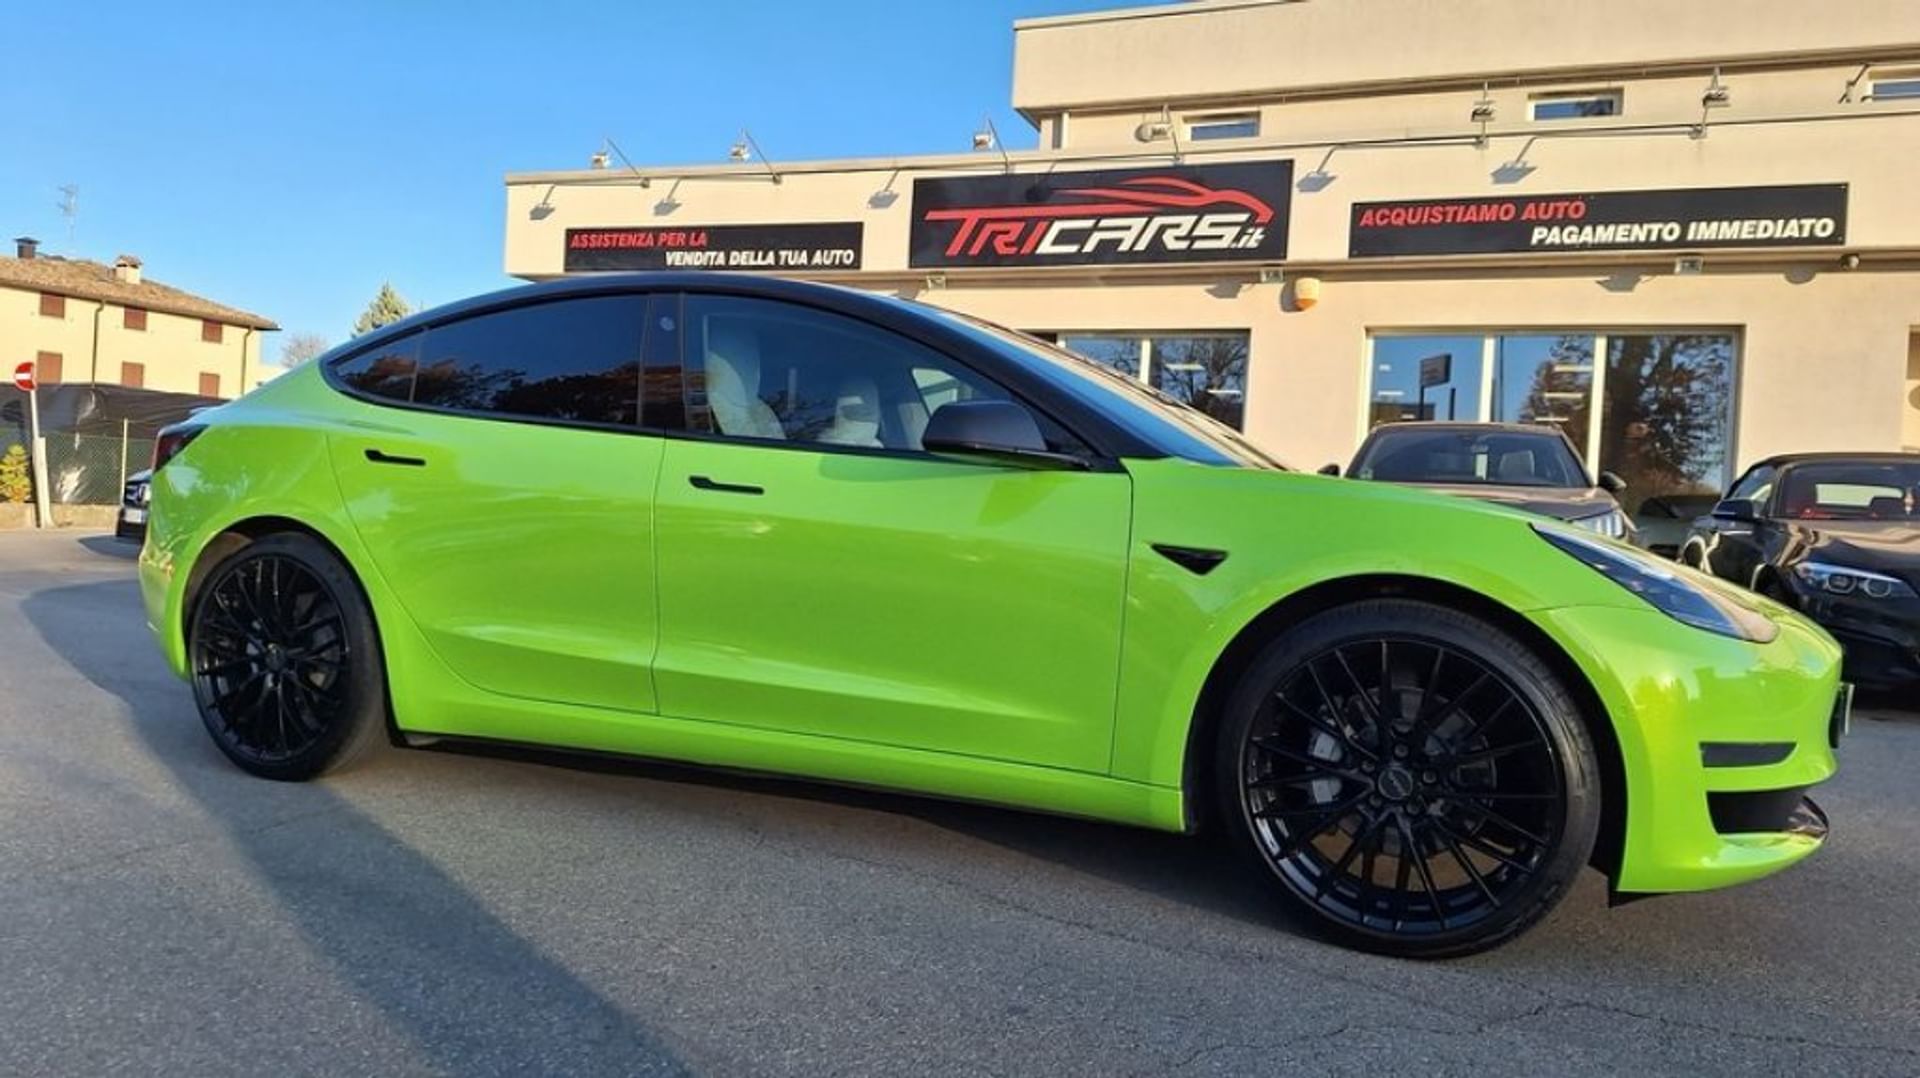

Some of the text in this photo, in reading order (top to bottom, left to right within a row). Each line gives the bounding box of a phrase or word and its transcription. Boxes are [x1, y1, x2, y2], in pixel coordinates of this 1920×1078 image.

[1359, 201, 1586, 227] ACQUISTIAMO AUTO
[570, 231, 708, 249] ASSISTENZA PER LA
[1530, 217, 1836, 245] PAGAMENTO IMMEDIATO
[665, 249, 856, 267] VENDITA DELLA TUA AUTO
